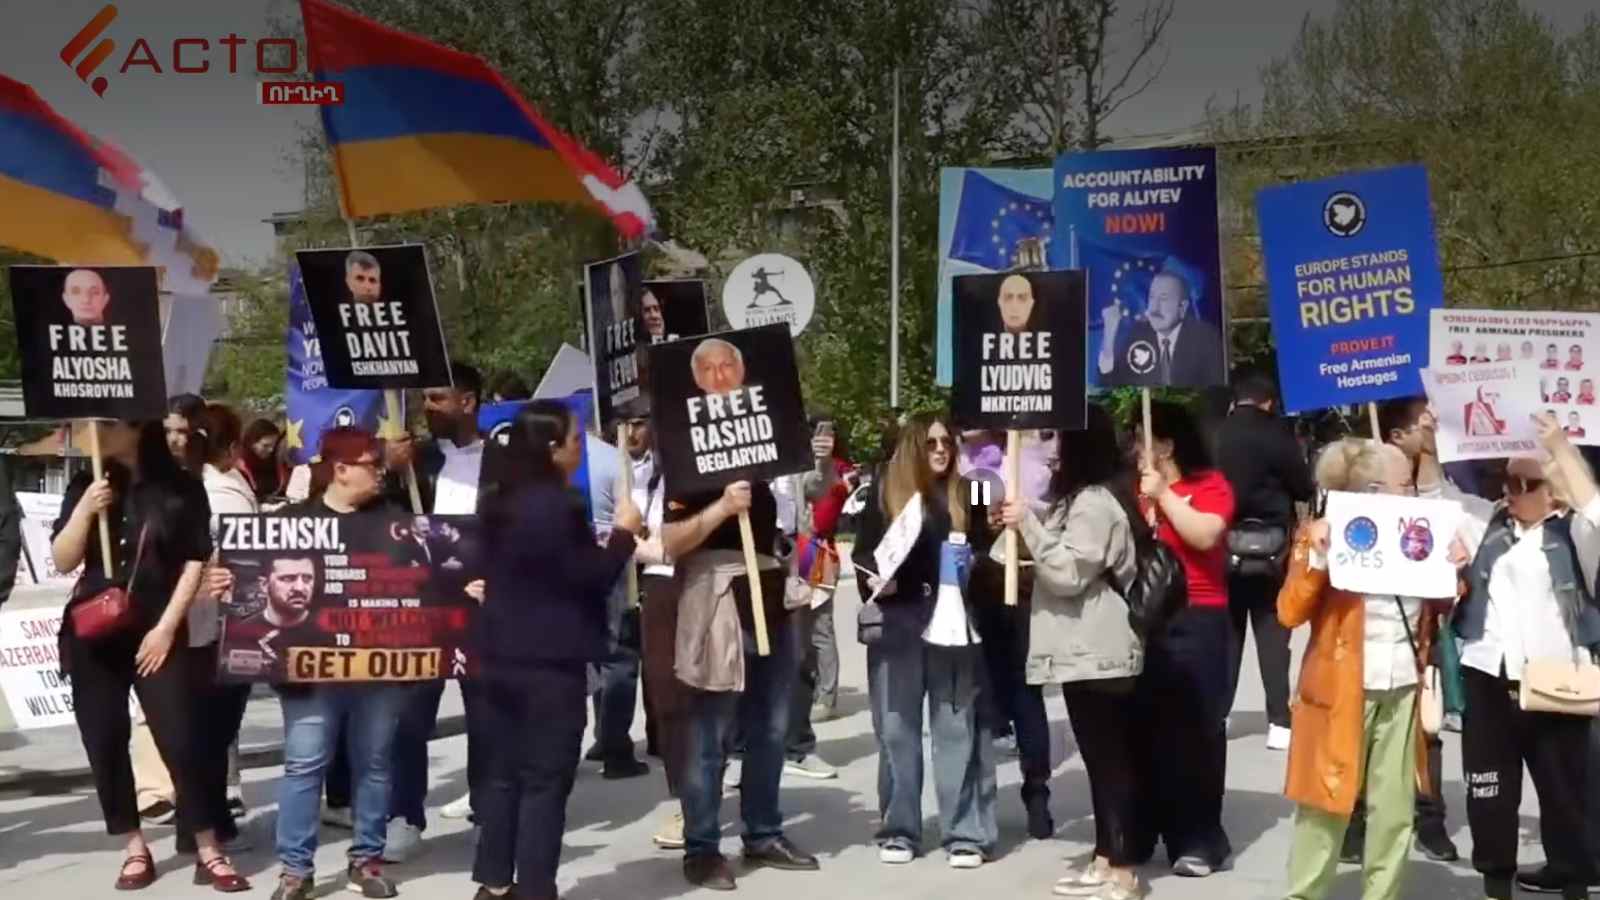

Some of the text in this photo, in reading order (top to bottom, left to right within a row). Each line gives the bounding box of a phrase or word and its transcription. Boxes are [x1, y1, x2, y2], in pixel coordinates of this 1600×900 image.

[1063, 165, 1206, 188] ACCOUNTABILITY
[1087, 187, 1182, 208] FOR ALIYEV
[1105, 212, 1165, 234] NOW!
[1295, 249, 1408, 277] EUROPE STANDS
[1297, 265, 1411, 297] FOR HUMAN
[338, 301, 406, 328] FREE
[1300, 287, 1415, 329] RIGHTS
[48, 324, 128, 351] FREE
[345, 330, 411, 358] DAVIT
[982, 331, 1052, 360] FREE
[1331, 337, 1378, 355] PROVE
[52, 356, 132, 380] ALYOSHA
[981, 363, 1052, 392] LYUDVIG
[1320, 353, 1411, 375] Free Armenian
[53, 382, 134, 398] KHOSROVYAN
[1337, 370, 1398, 388] Hostages
[686, 385, 768, 424] FREE
[980, 394, 1052, 413] MKRTCHYAN
[690, 414, 773, 453] RASHID
[695, 442, 779, 475] BEGLARYAN
[221, 517, 346, 552] ZELENSKI,
[348, 598, 358, 608] IS
[360, 598, 399, 608] MAKING
[335, 633, 350, 646] TO
[295, 651, 356, 678] GET
[368, 647, 436, 677] OUT!
[24, 695, 64, 716] WILL
